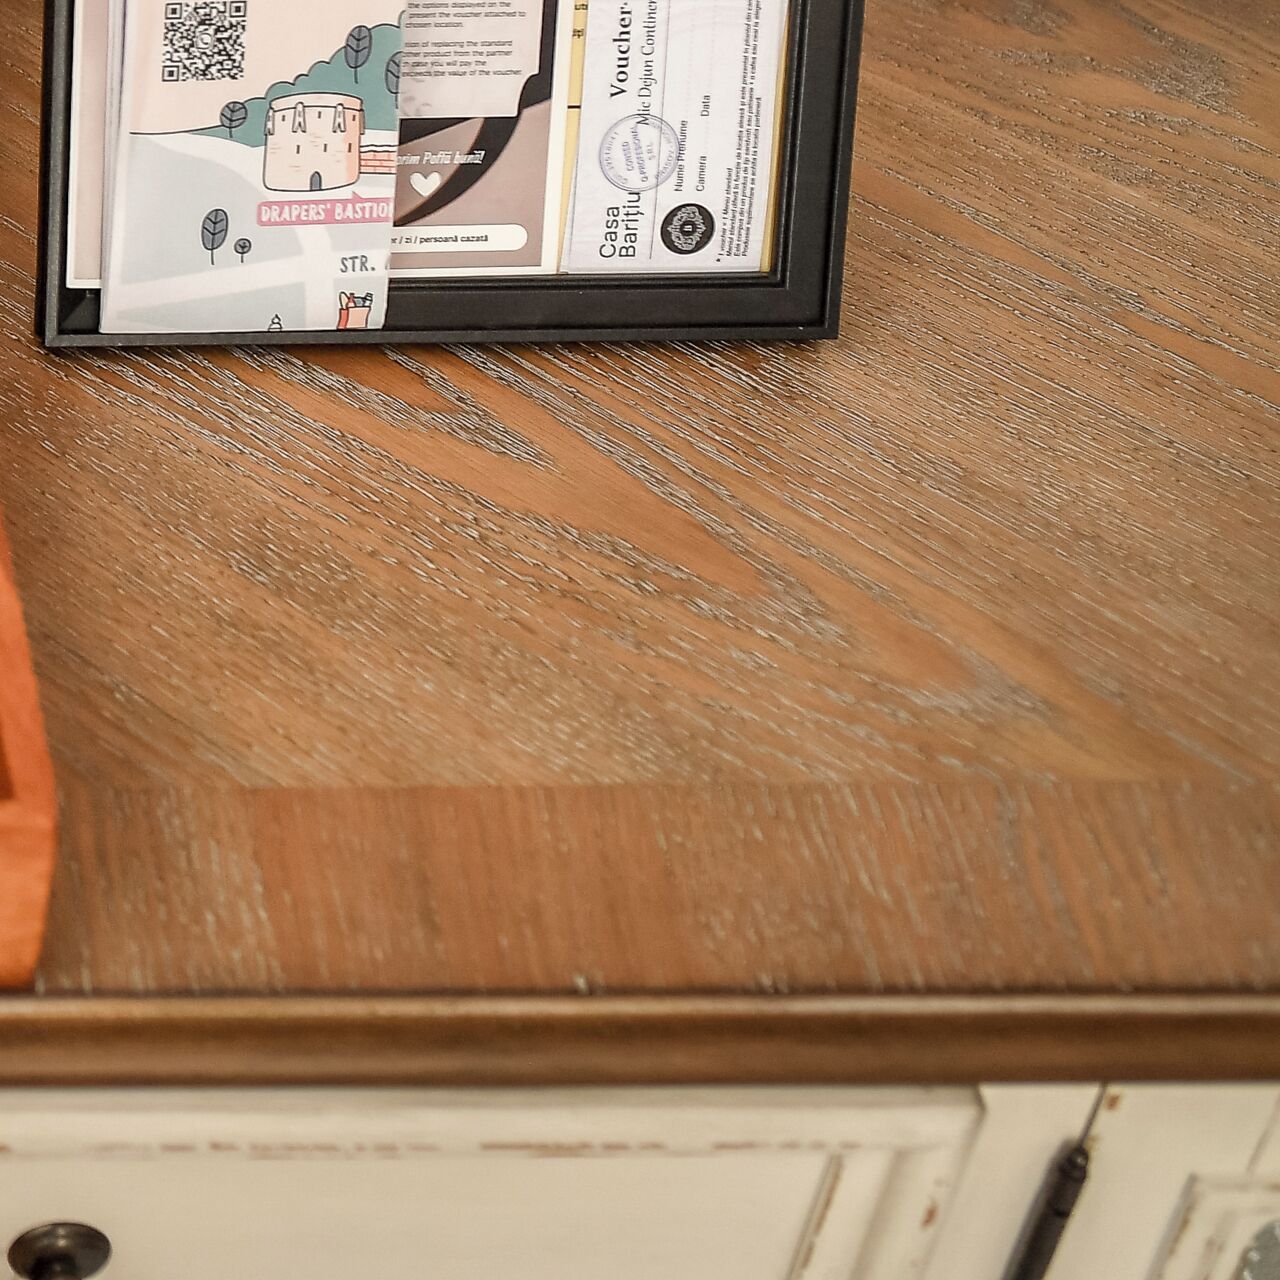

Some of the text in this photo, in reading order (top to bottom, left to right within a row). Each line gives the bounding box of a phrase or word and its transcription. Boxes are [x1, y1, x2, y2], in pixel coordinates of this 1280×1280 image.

[638, 56, 656, 104] Dejun
[636, 108, 651, 125] Mic
[700, 95, 711, 117] Data
[674, 120, 688, 192] Nume Prenume
[696, 155, 707, 192] Camera
[261, 204, 331, 222] DRAPERS'
[420, 235, 458, 244] persoană
[600, 206, 620, 258] Casa
[340, 255, 375, 273] STR.
